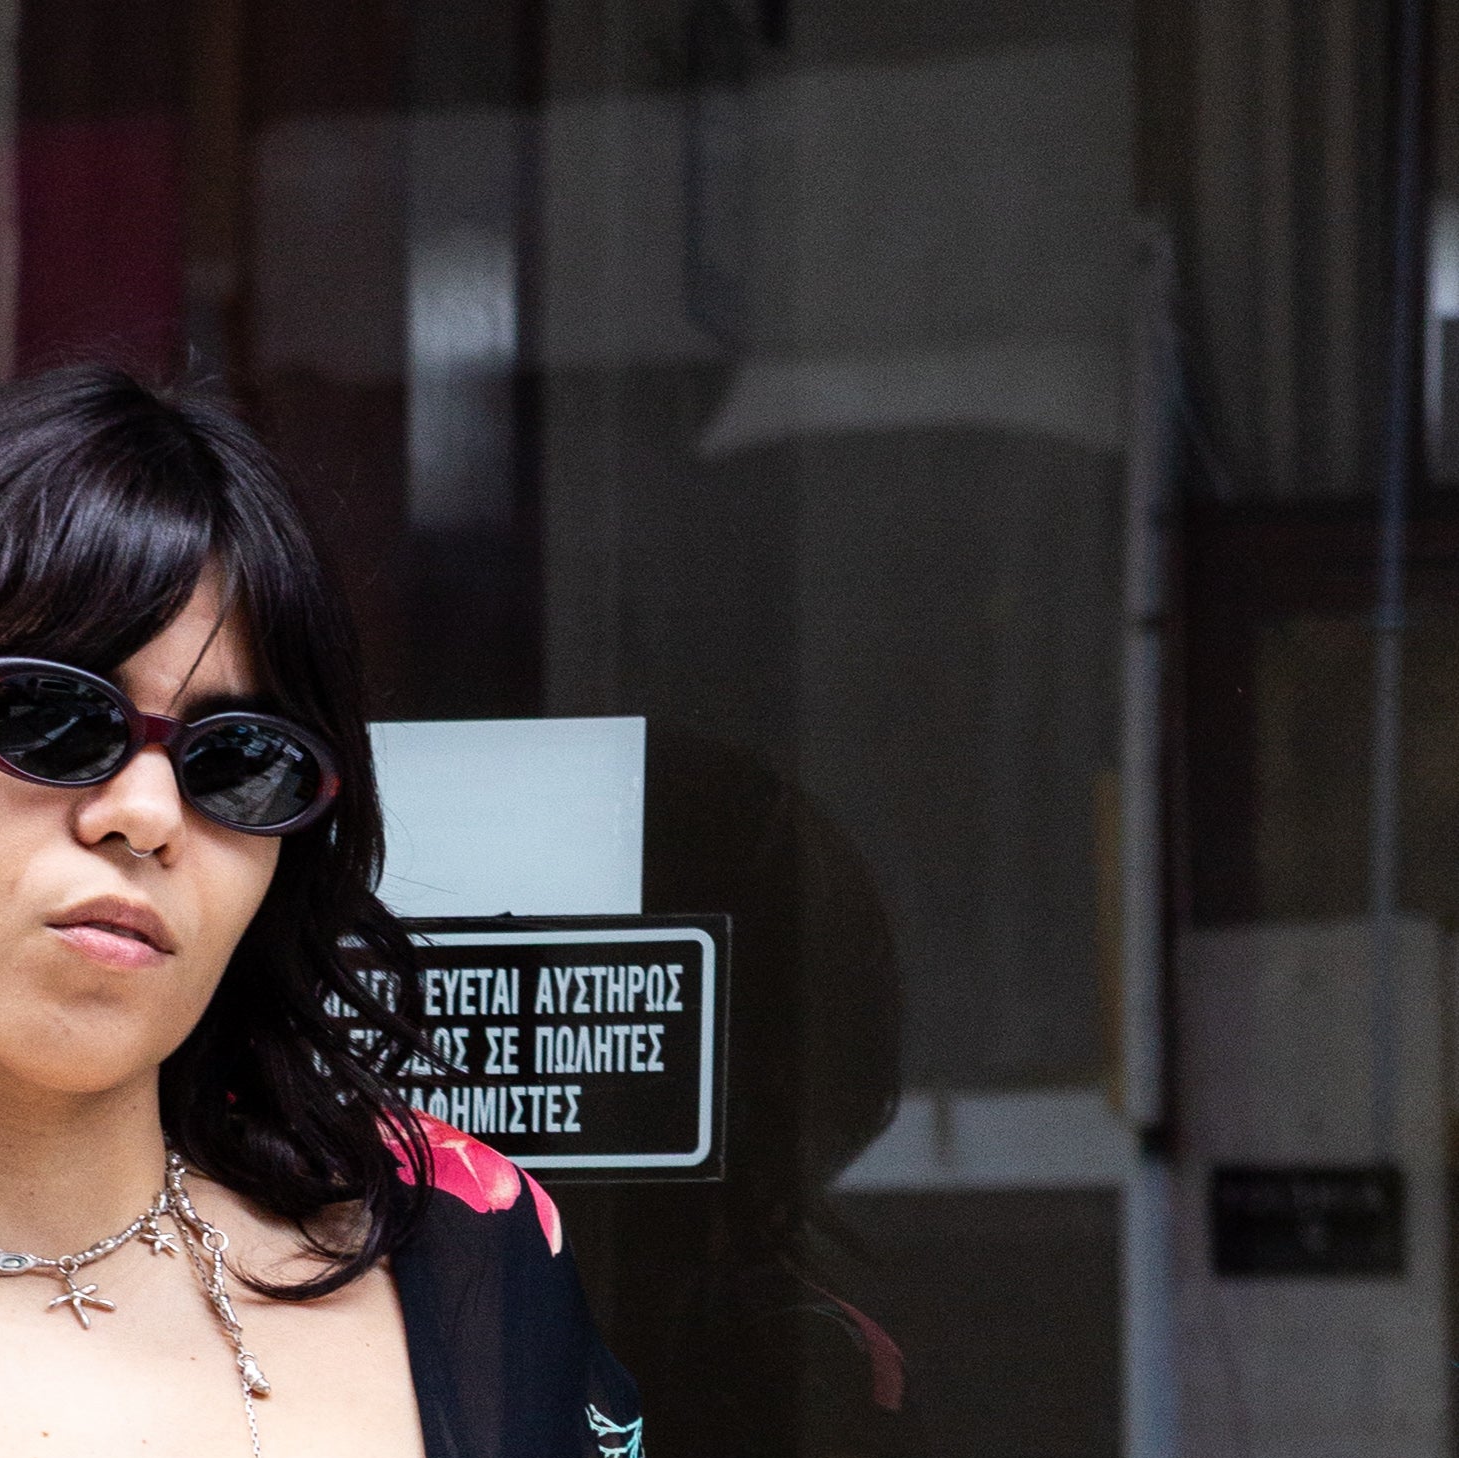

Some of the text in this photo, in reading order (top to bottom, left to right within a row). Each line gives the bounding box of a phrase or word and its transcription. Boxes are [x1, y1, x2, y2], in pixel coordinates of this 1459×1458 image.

[534, 964, 684, 1015] ΑΥΣΤΗΡΩΣ
[484, 1026, 520, 1075] ΣΕ
[534, 1023, 665, 1074] ΠΩΛΗΤΕΣ
